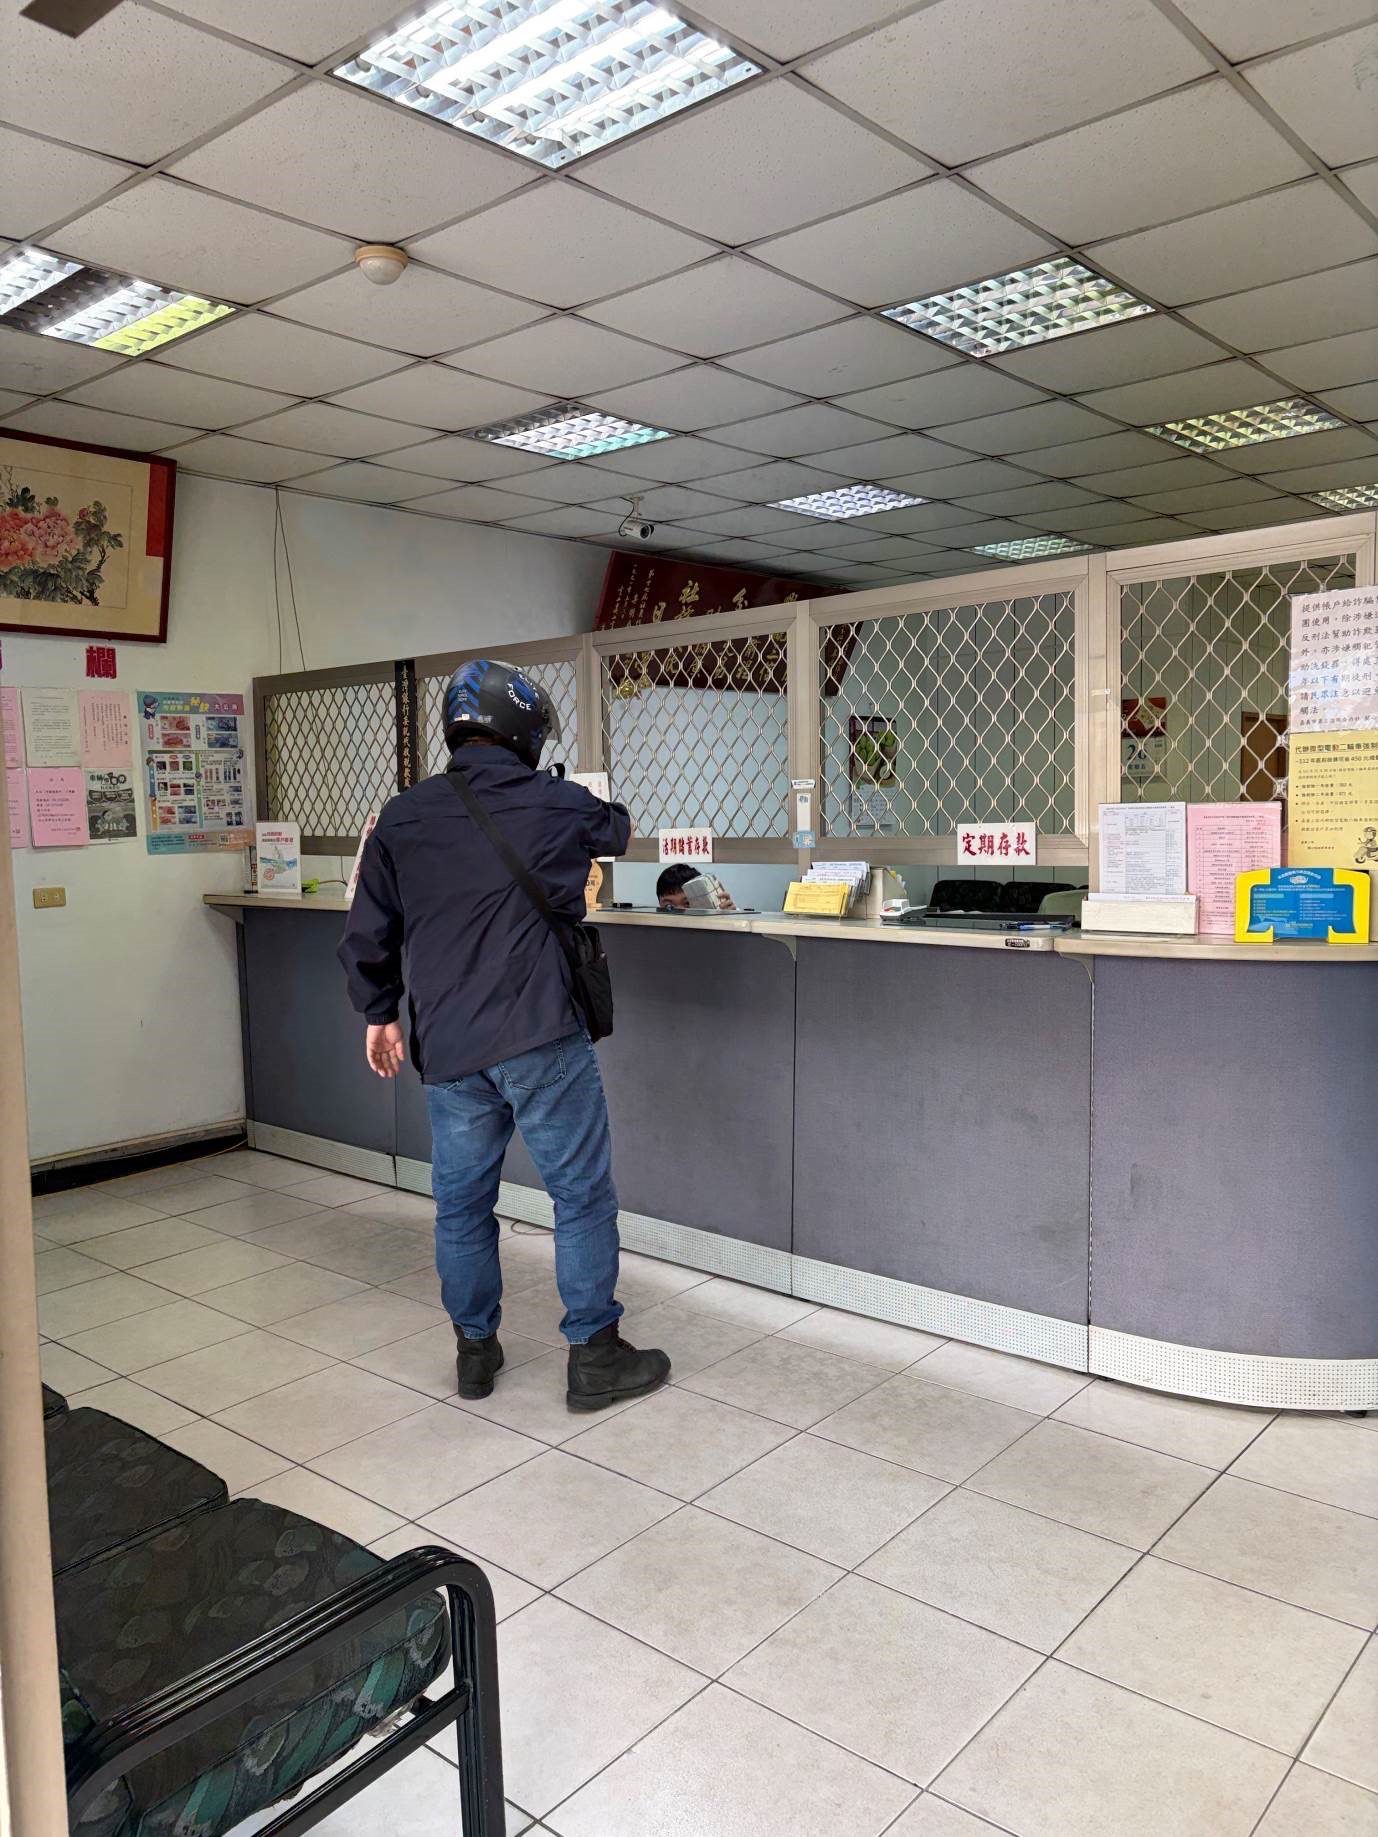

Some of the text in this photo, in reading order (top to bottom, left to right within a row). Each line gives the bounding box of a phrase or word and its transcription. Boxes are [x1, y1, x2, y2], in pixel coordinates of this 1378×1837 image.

[1302, 595, 1378, 613] 提供帳戶給詐騙
[85, 644, 118, 680] 欄
[506, 682, 532, 711] FORCE
[662, 835, 709, 855] 活期儲蓄存款
[962, 832, 1030, 856] 定期存款
